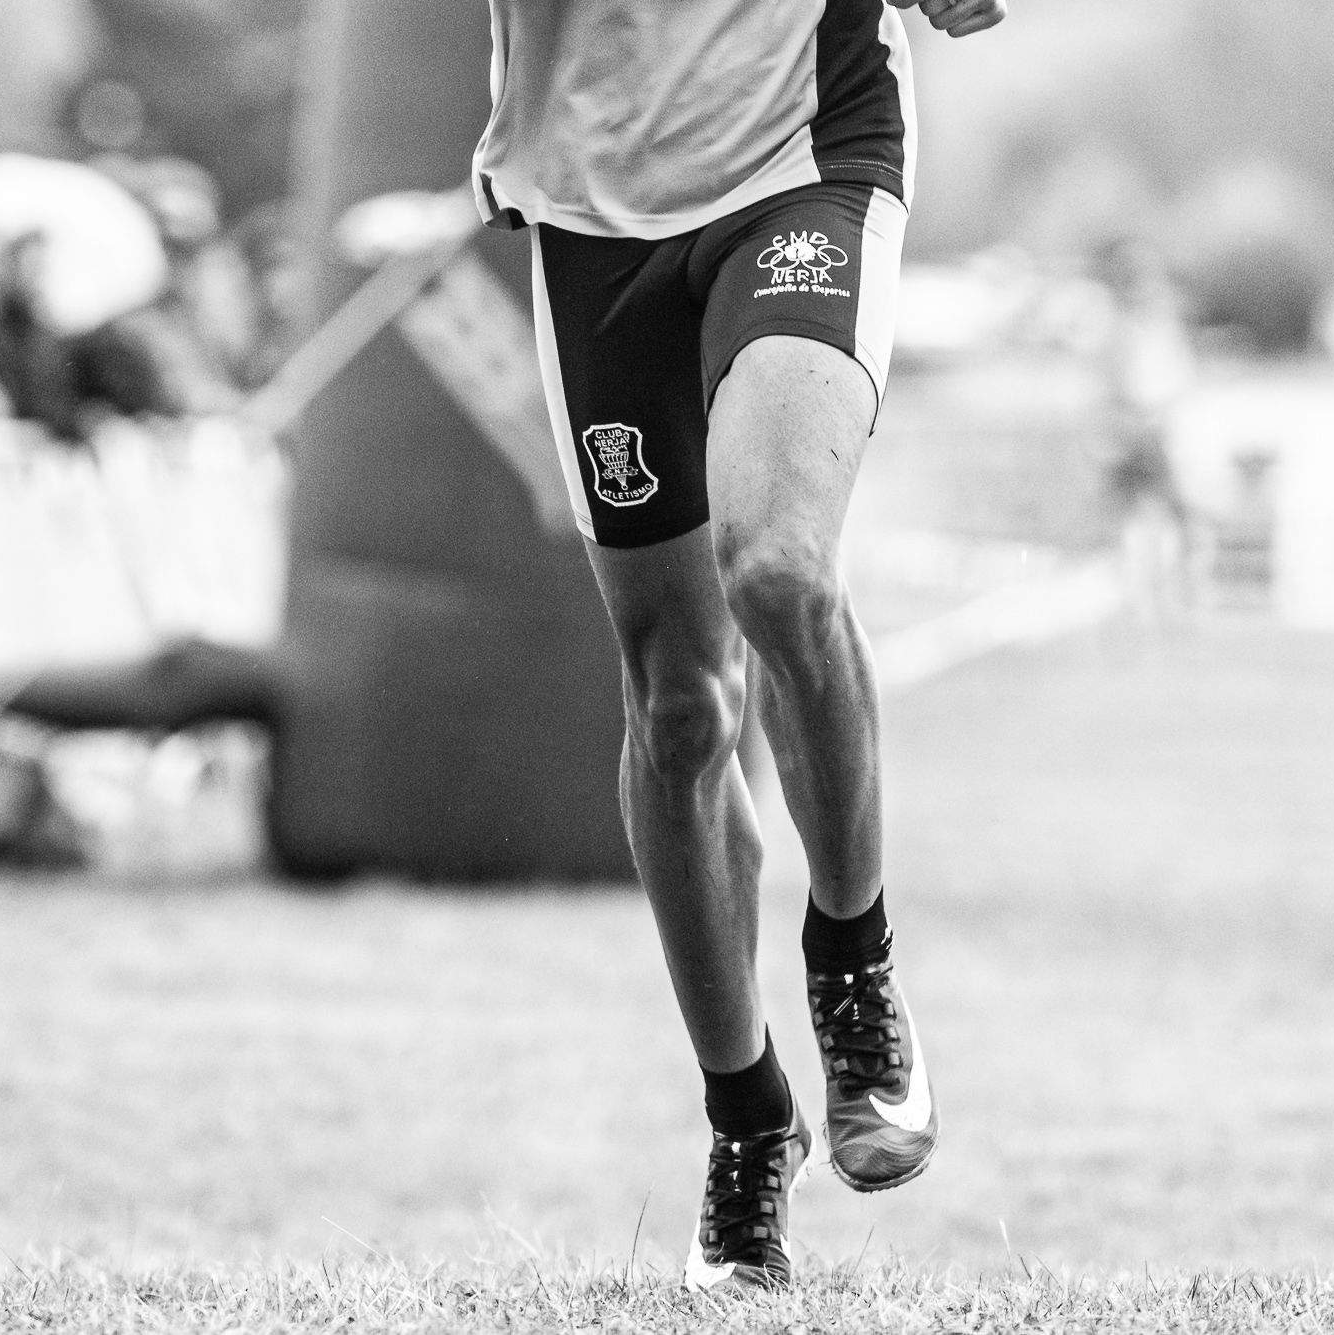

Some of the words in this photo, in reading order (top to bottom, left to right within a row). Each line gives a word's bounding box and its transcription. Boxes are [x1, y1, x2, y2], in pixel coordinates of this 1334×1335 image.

[772, 230, 829, 248] CMD
[770, 268, 833, 285] NERJA
[594, 437, 627, 447] NERJA
[595, 429, 623, 439] CLUB
[602, 483, 653, 500] ATLETISMO
